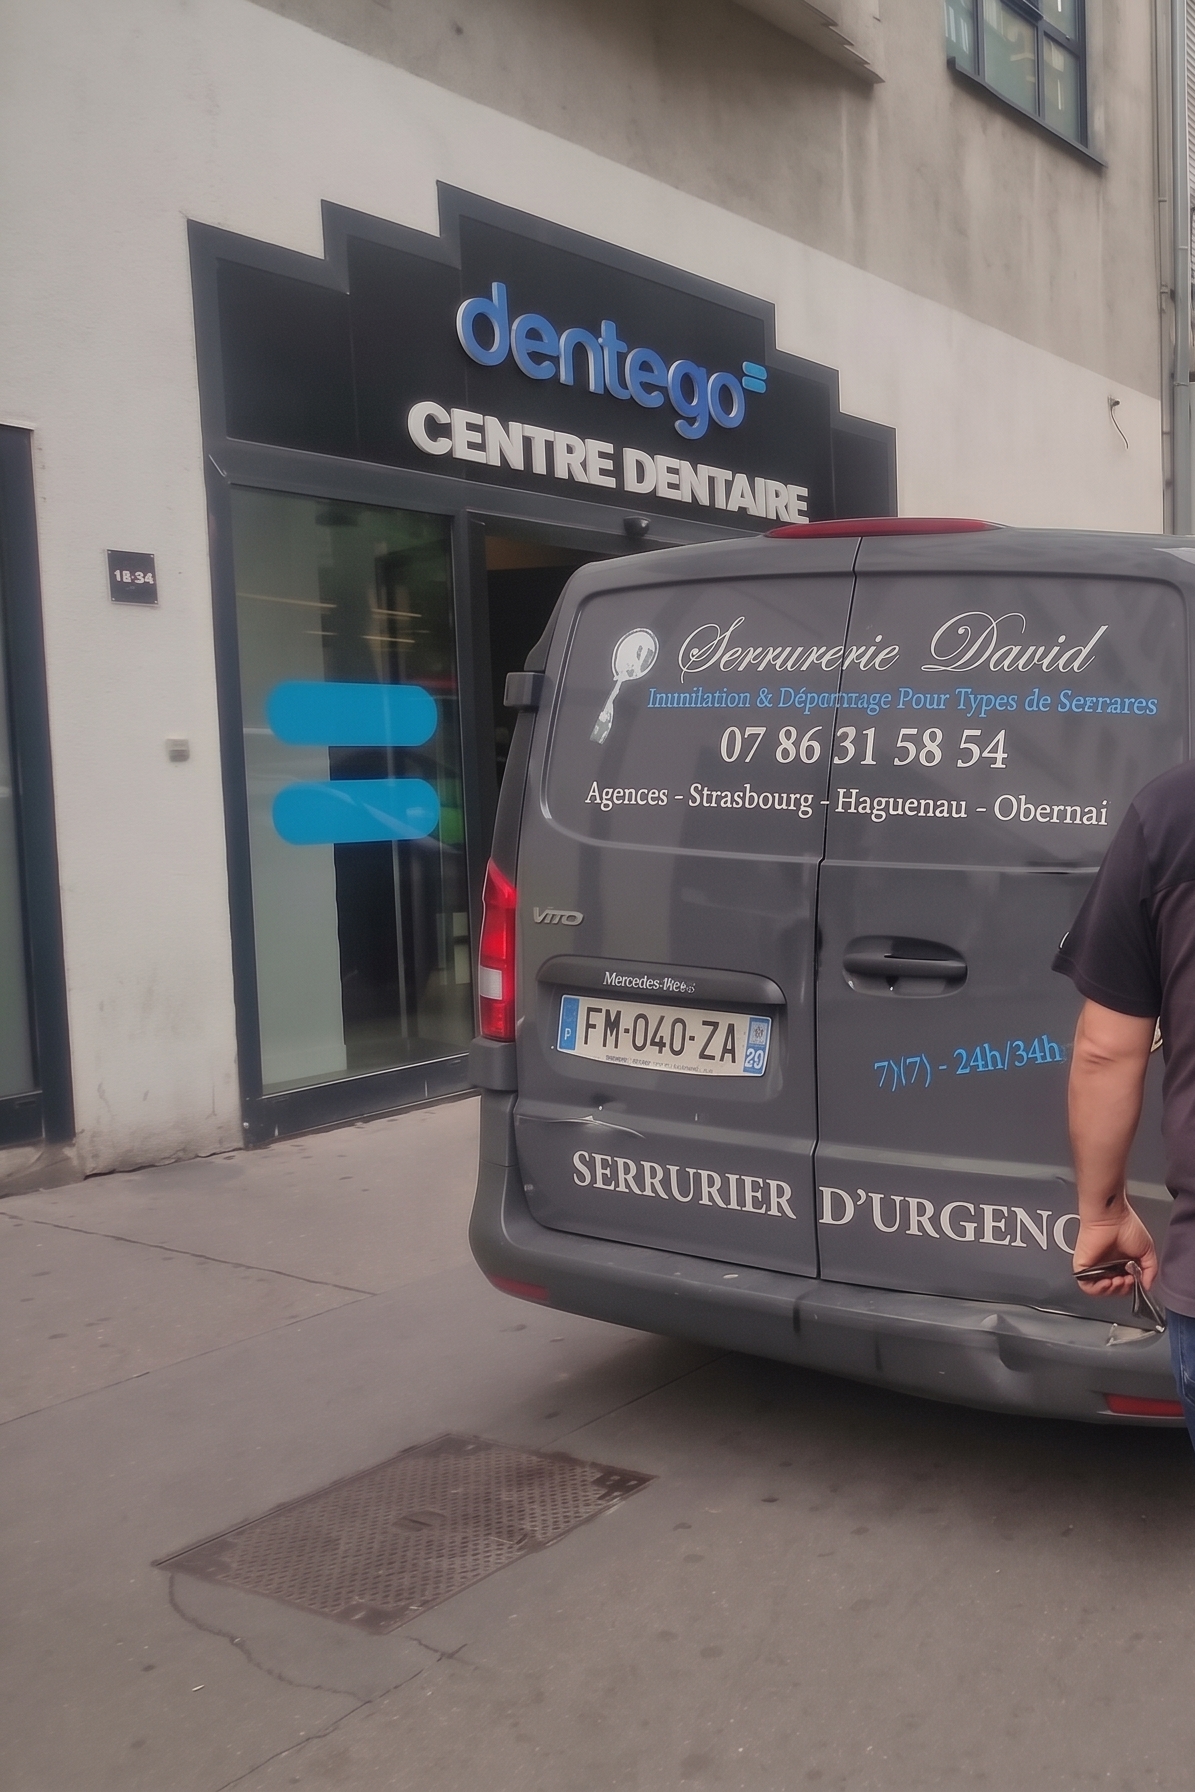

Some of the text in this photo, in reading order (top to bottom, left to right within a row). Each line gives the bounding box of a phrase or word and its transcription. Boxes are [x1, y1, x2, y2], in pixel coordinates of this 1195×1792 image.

[456, 281, 746, 440] dentego
[407, 401, 810, 524] CENTRE DENTAIRE
[678, 610, 1109, 684] Serrurerie David
[756, 687, 773, 708] &
[897, 687, 949, 710] Pour
[956, 688, 1018, 718] Types
[1024, 688, 1051, 712] de
[719, 725, 1008, 769] 07 86 31 58 54
[585, 781, 668, 811] Agences
[688, 783, 814, 819] Strasbourg
[835, 788, 967, 822] Haguenau
[994, 794, 1108, 826] Obernai
[533, 906, 584, 926] VITO
[584, 1006, 736, 1063] FM-040-ZA
[572, 1149, 1080, 1255] SERRURIER D'URGENC
